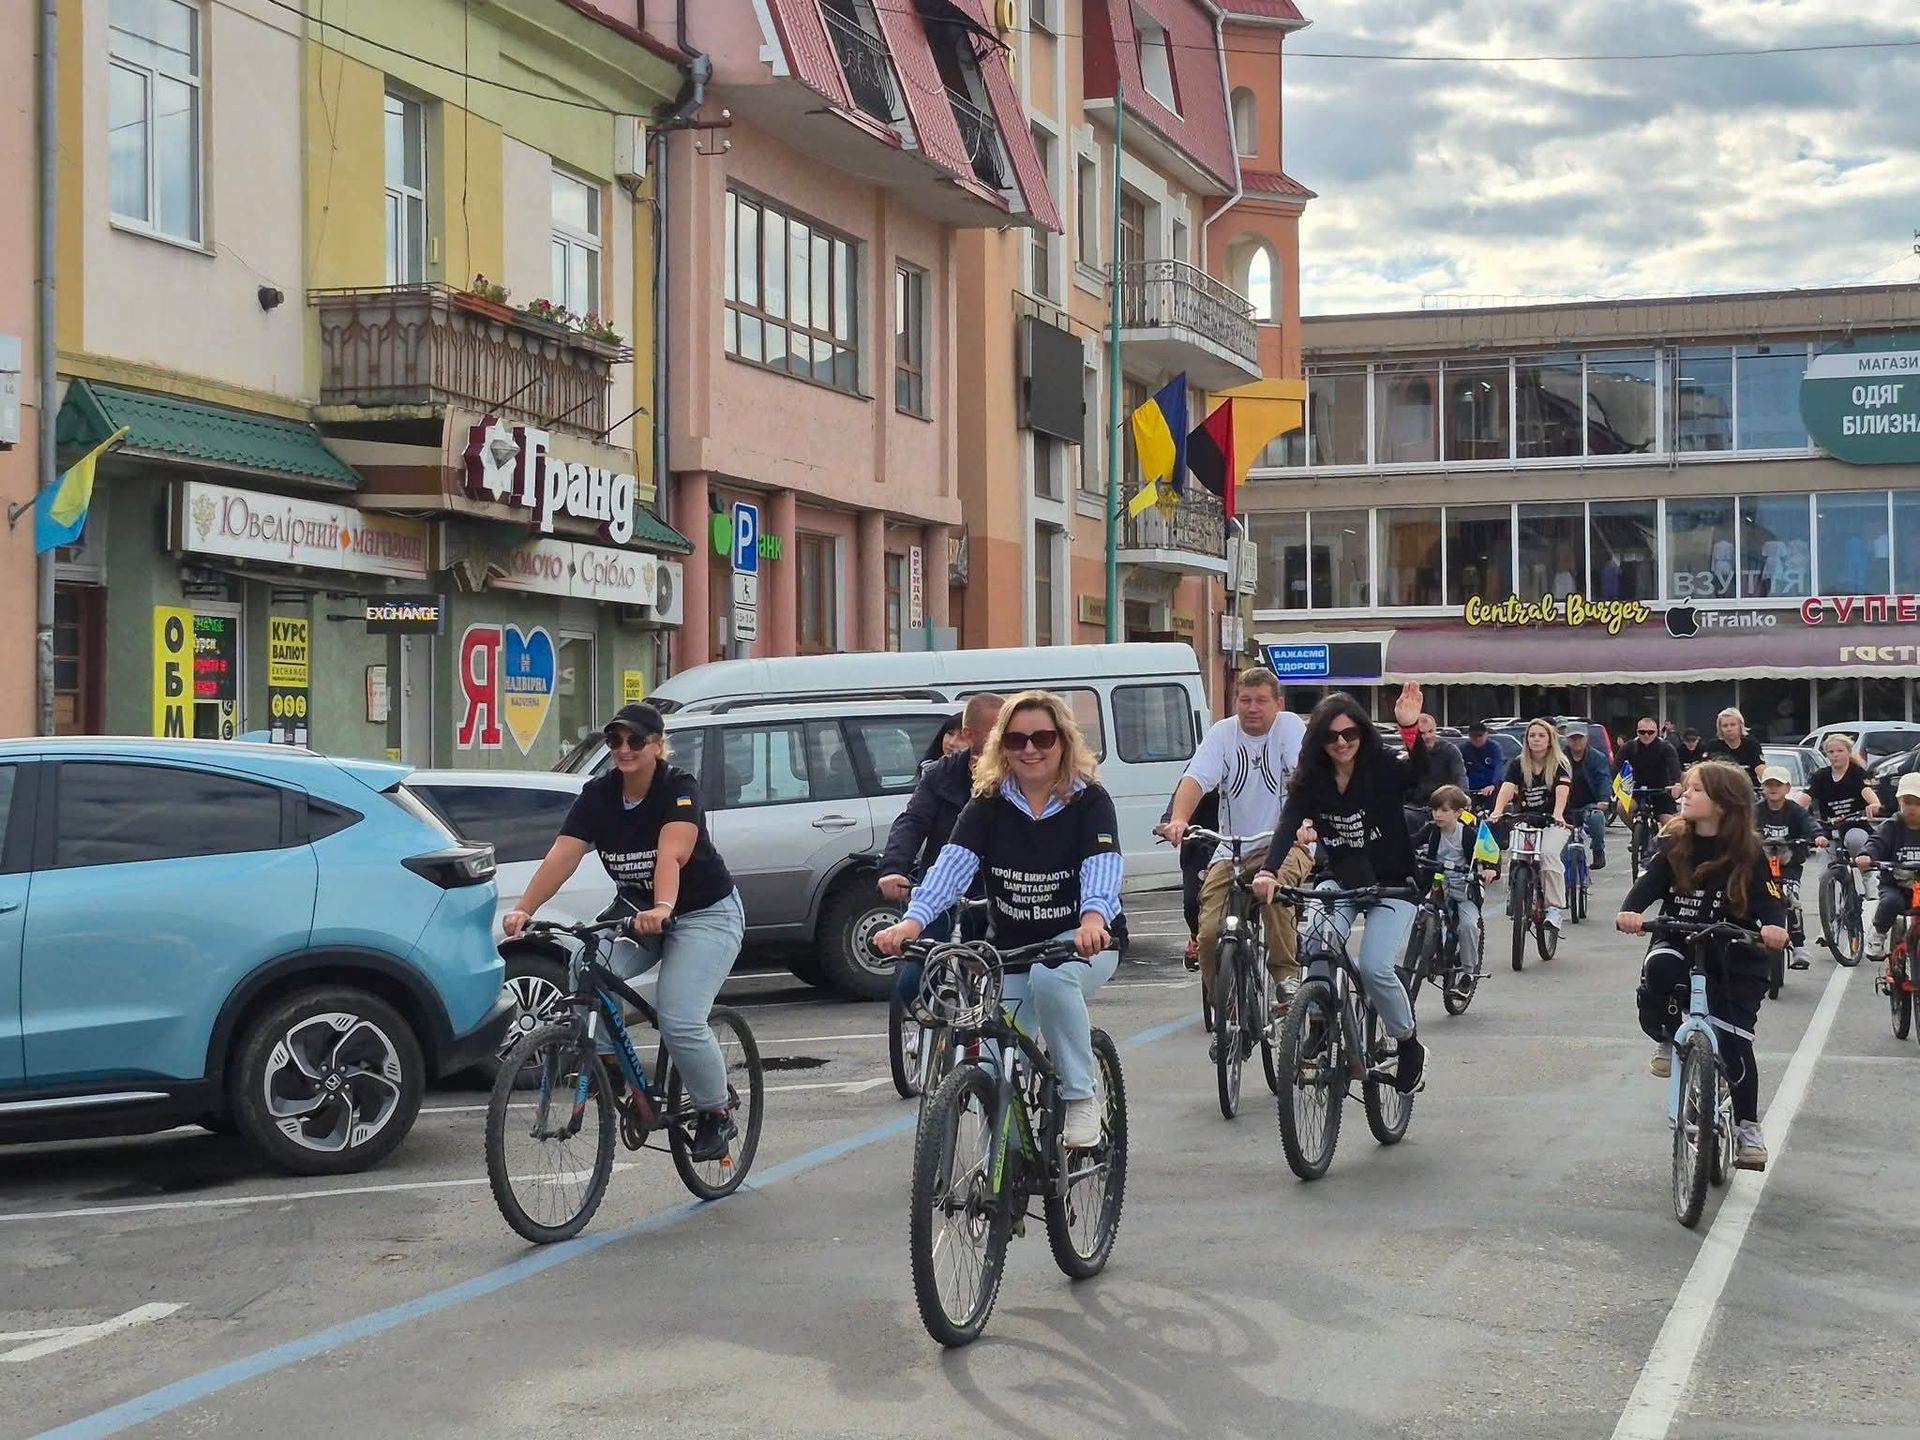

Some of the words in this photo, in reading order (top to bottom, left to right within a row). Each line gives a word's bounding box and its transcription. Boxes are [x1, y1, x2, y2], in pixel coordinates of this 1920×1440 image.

[1859, 356, 1918, 370] МАГАЗИ
[1852, 384, 1904, 409] ОДЯГ
[219, 495, 340, 559] Ювелірний
[352, 528, 422, 561] магазин
[758, 535, 782, 560] анк
[512, 551, 562, 581] олото
[580, 552, 636, 596] Срібло
[366, 607, 439, 621] EXCHANGE
[1465, 594, 1557, 626] Central
[1566, 594, 1650, 635] Burger
[1701, 611, 1777, 628] iFranko
[1800, 595, 1918, 625] СУПЕ
[272, 622, 306, 643] КУРС
[272, 644, 306, 661] ВАЛЮТ
[1839, 646, 1920, 662] гаст
[457, 628, 502, 745] Я
[991, 867, 1011, 879] ГЕРОЇ
[1012, 871, 1022, 881] НЕ
[1033, 905, 1072, 920] Василь
